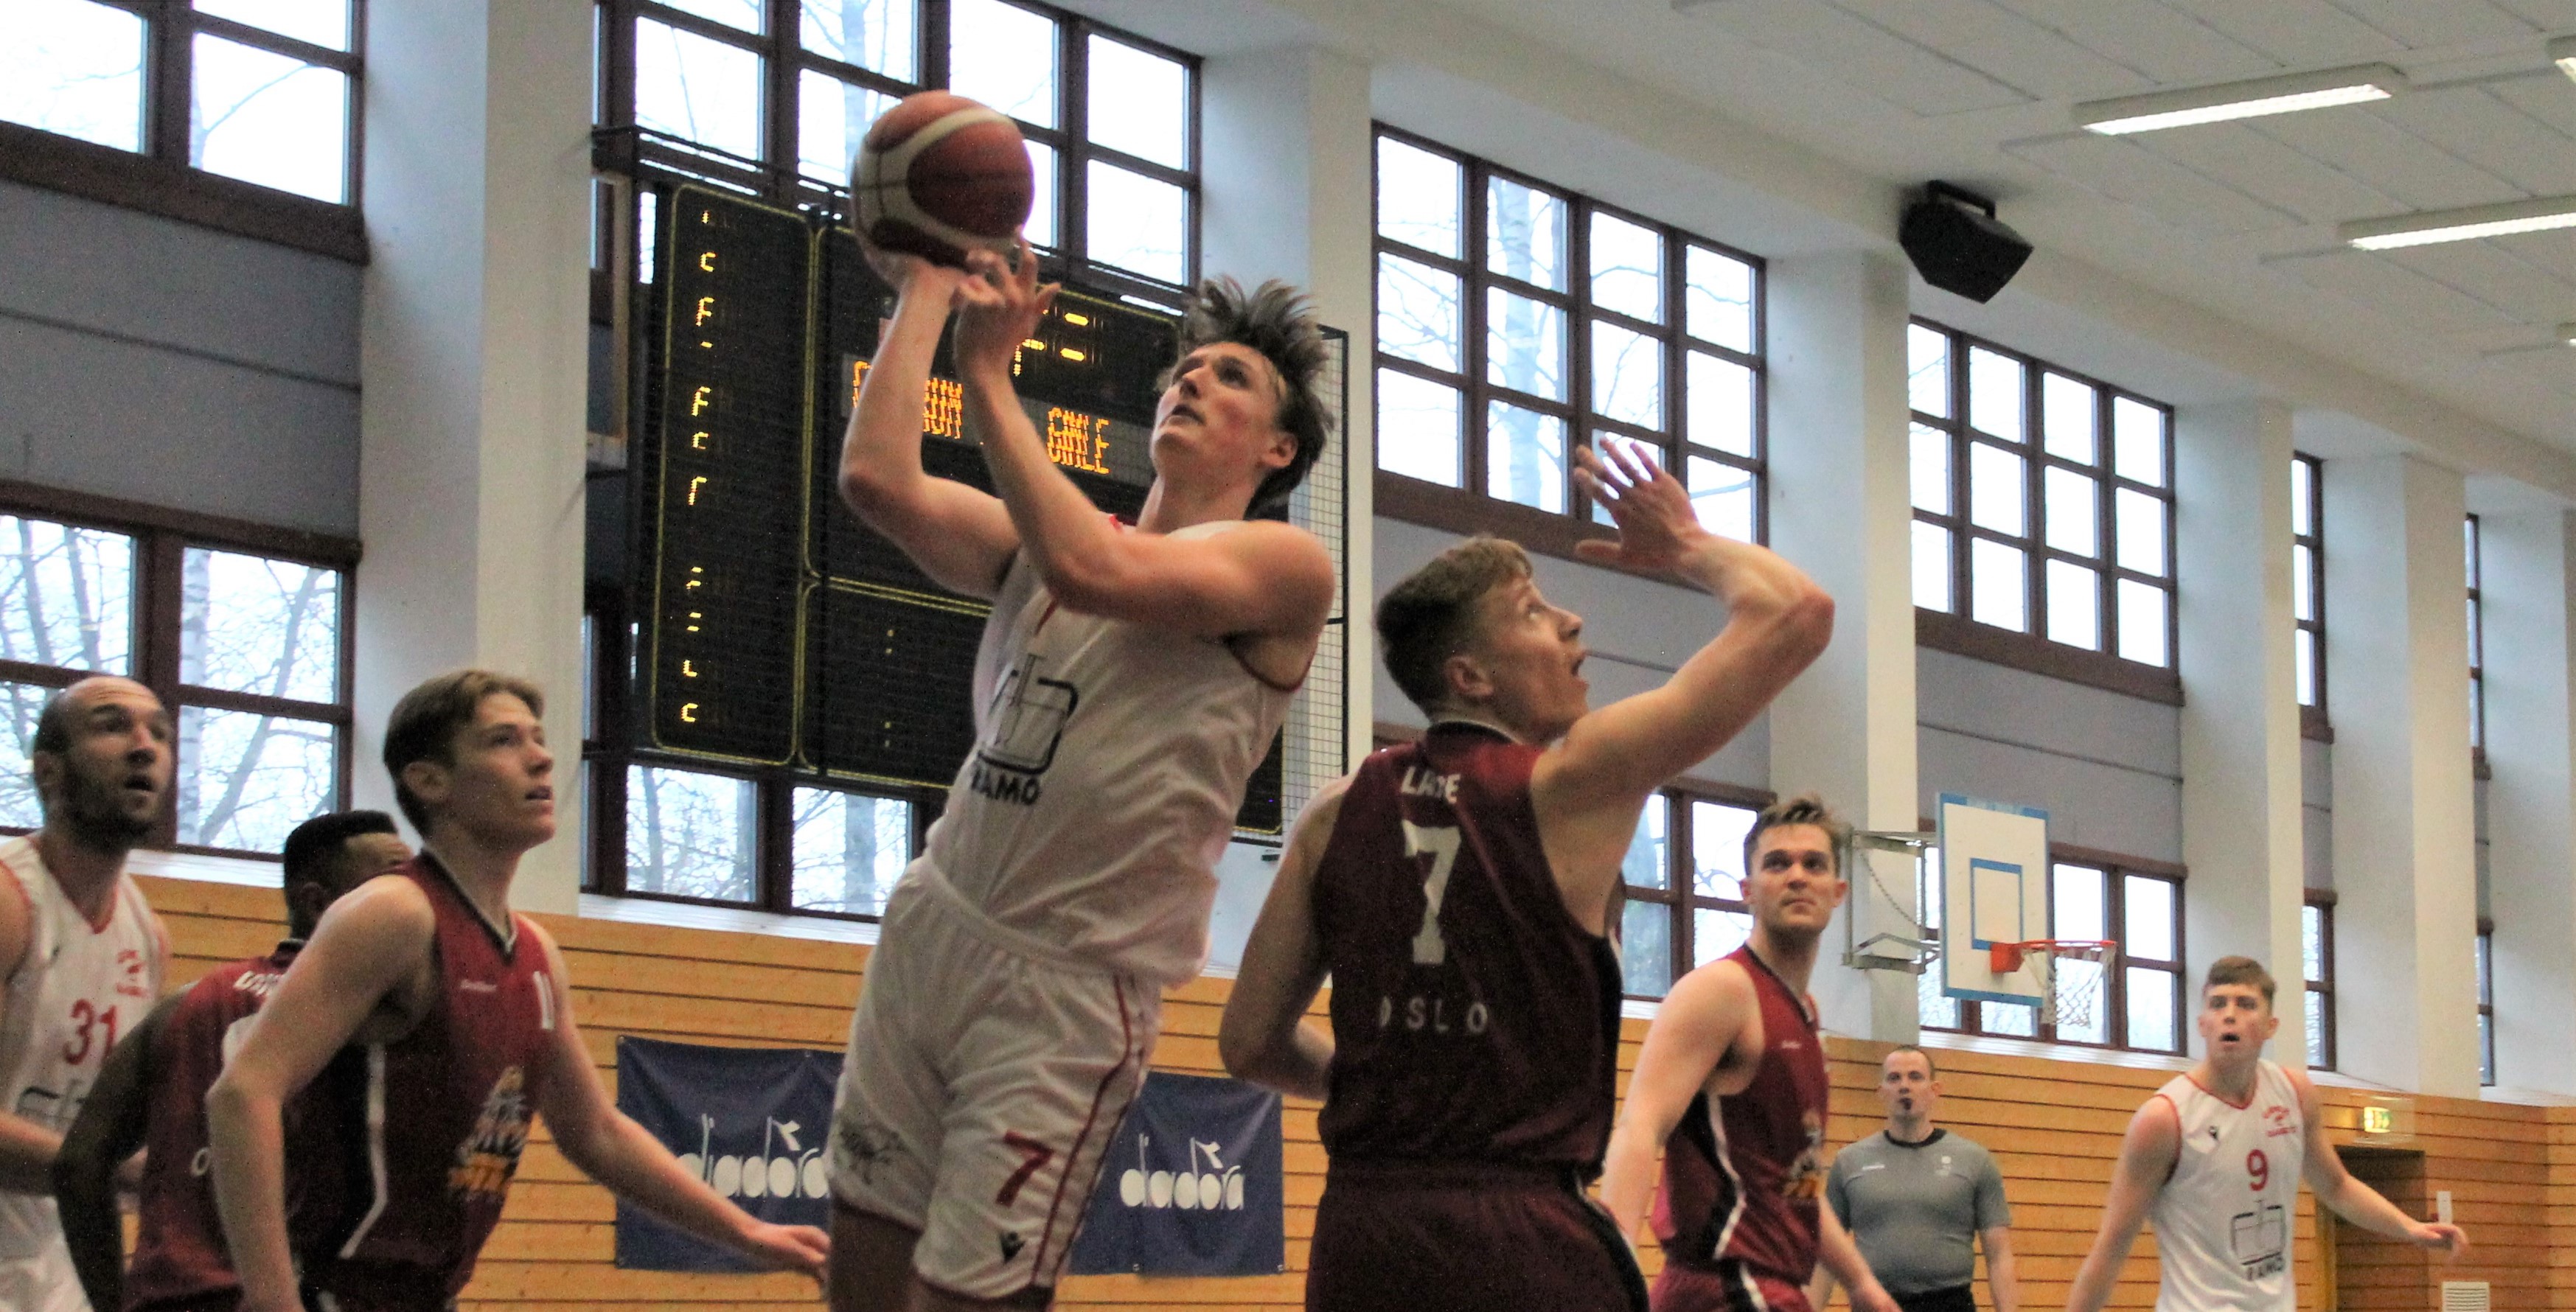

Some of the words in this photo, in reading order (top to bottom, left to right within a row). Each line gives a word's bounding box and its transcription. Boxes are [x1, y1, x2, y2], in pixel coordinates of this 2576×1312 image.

[1402, 820, 1461, 964] 7
[63, 999, 118, 1065] 31
[675, 1113, 832, 1199] diadora
[996, 1131, 1054, 1207] 7
[1120, 1133, 1245, 1210] diadora
[2246, 1149, 2269, 1192] 9
